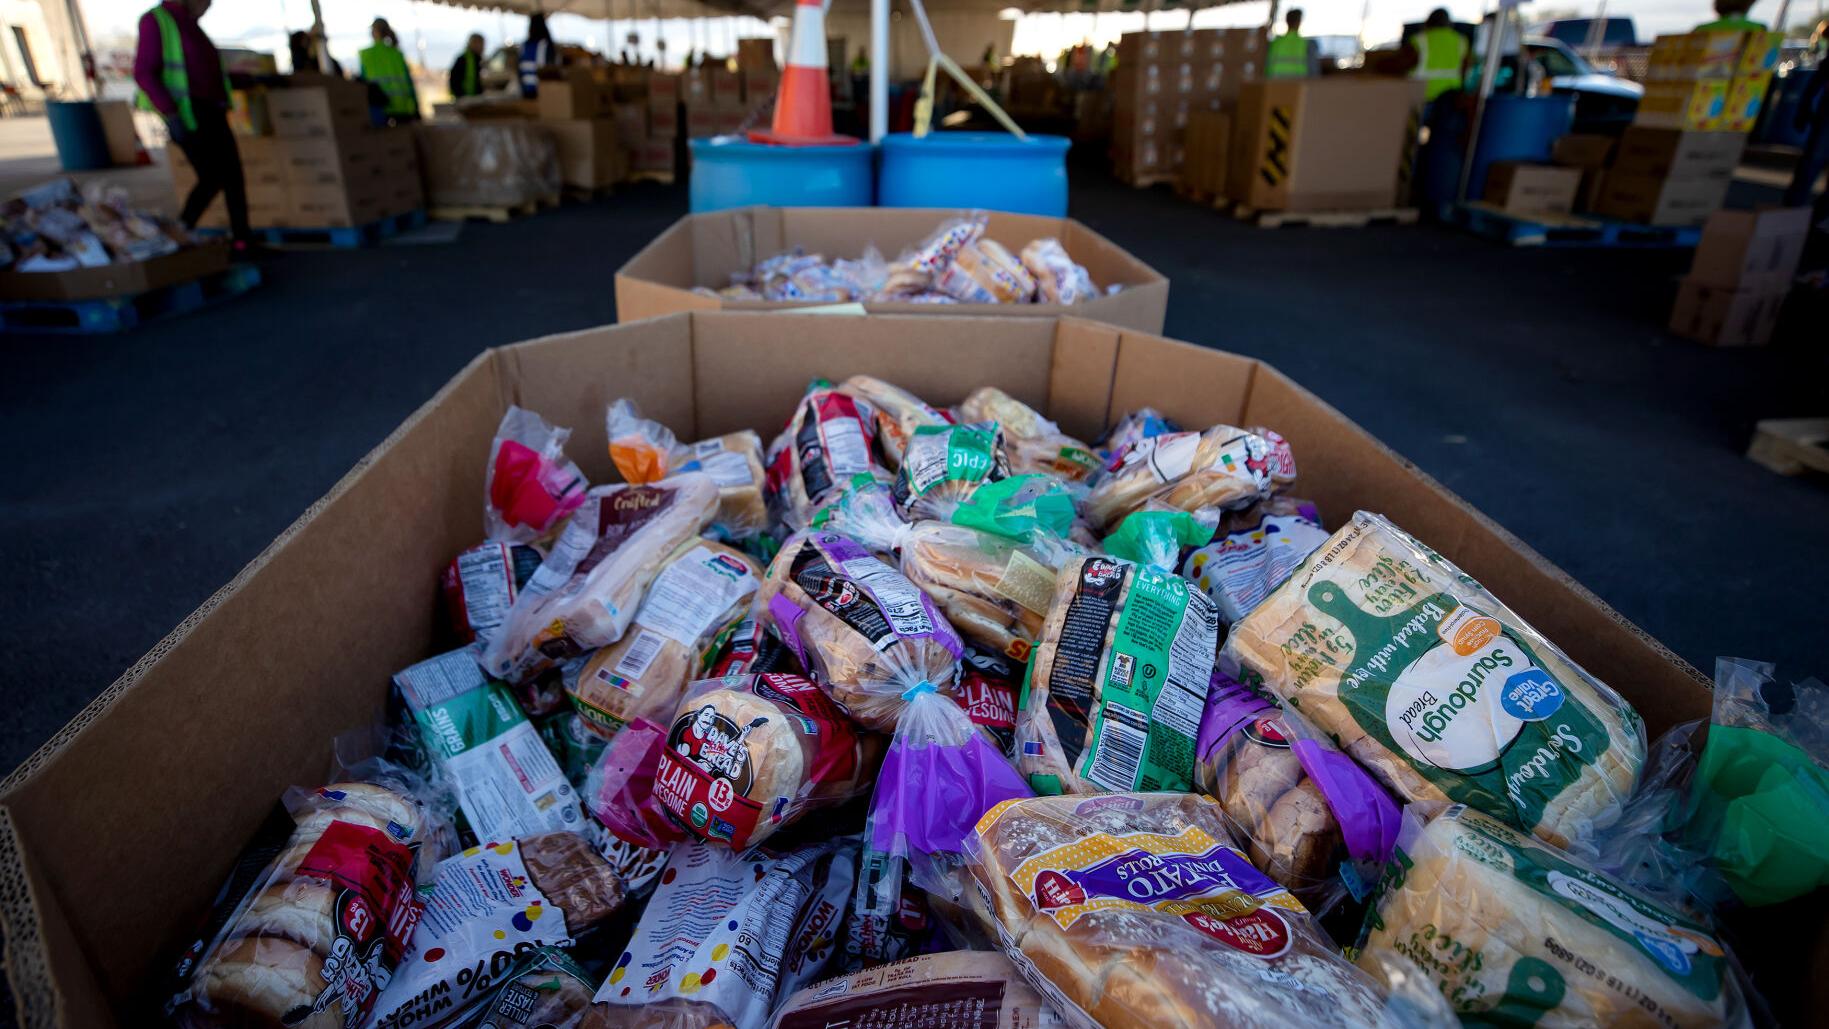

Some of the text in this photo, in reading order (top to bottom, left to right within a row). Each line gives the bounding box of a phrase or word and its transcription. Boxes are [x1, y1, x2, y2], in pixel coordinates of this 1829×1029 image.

[613, 494, 661, 512] Crafted
[1323, 551, 1336, 564] LB
[1338, 540, 1349, 551] OZ
[1358, 554, 1397, 592] slice
[1363, 559, 1410, 605] in every
[1135, 580, 1182, 606] EVERYTHING
[1375, 567, 1431, 615] 2g Fiber
[1281, 621, 1318, 655] slice
[1325, 634, 1354, 656] 5g
[1346, 602, 1446, 689] Baked with love
[1415, 649, 1514, 744] Sourdough
[1508, 679, 1540, 702] Value
[1515, 680, 1559, 713] Great
[1399, 691, 1438, 731] Bread
[433, 707, 467, 753] GRAINS
[706, 727, 749, 764] DAVE'S
[655, 754, 699, 802] PLAIN
[699, 742, 743, 781] BREAD
[652, 782, 690, 818] WESOME
[1116, 855, 1165, 880] ROLLS
[738, 935, 752, 947] 60
[1419, 923, 1484, 974] slice
[1543, 936, 1575, 964] 680g
[644, 966, 672, 987] ONDER
[890, 955, 920, 967] BREAD
[390, 995, 453, 1029] WHOL
[498, 1001, 531, 1025] KILLER
[504, 989, 536, 1010] TASTE
